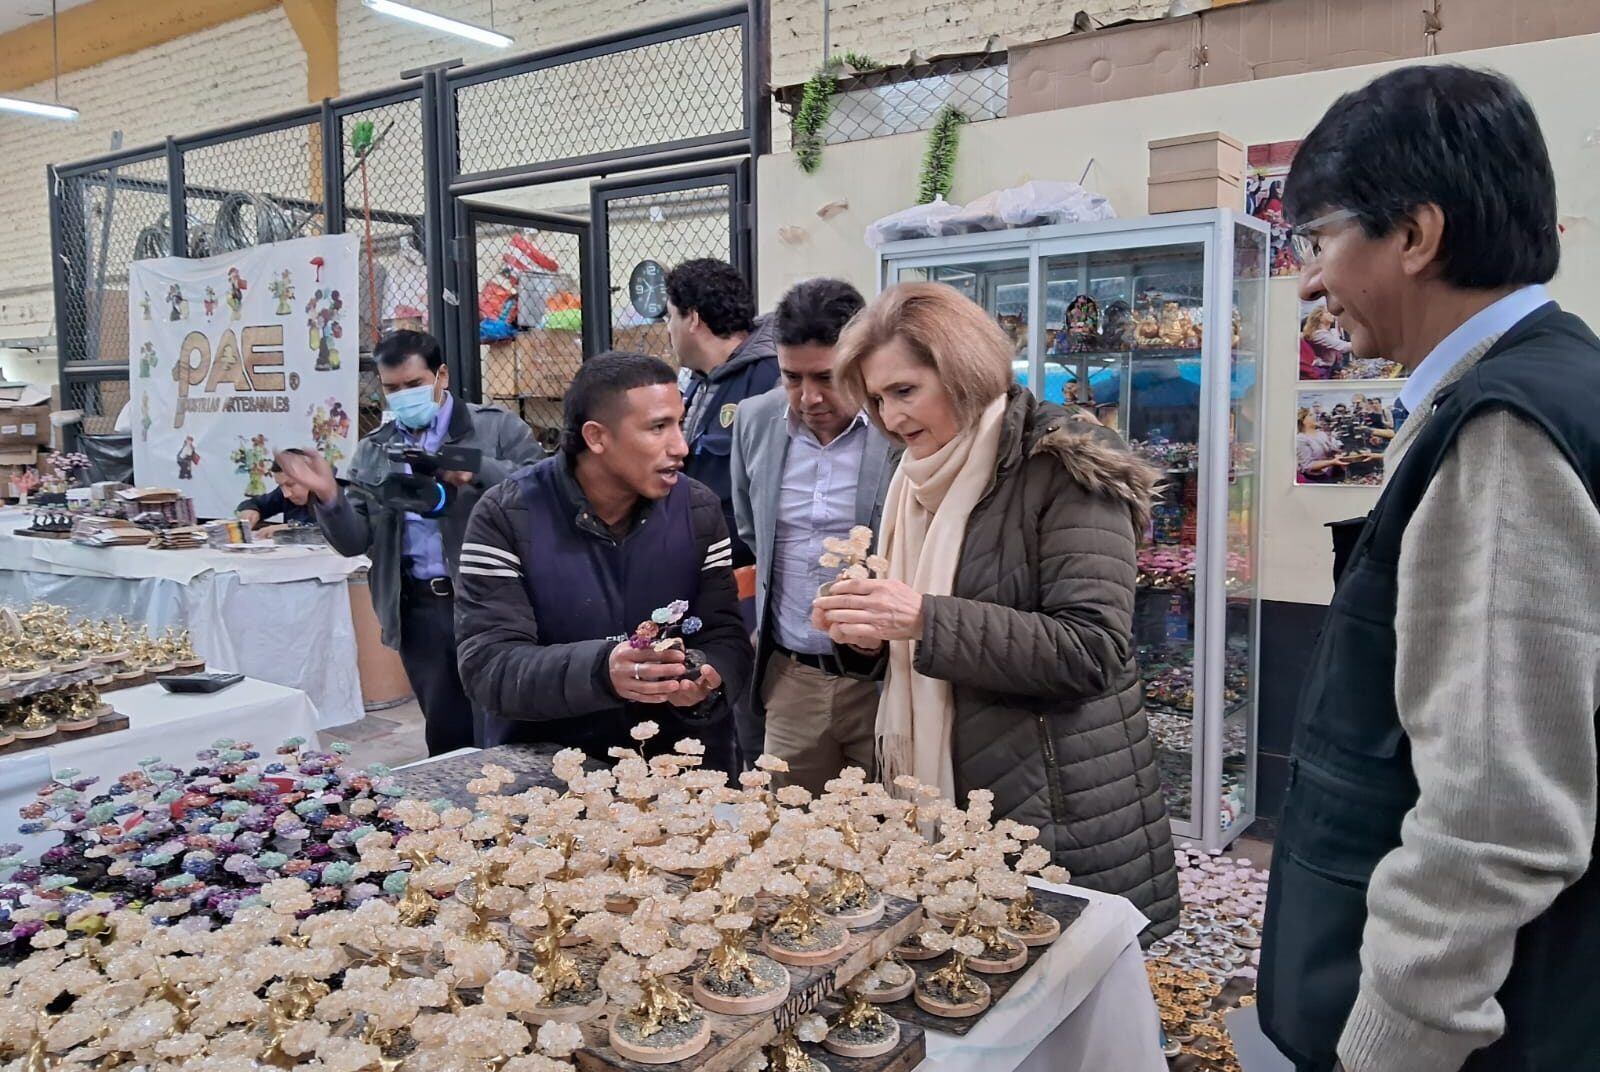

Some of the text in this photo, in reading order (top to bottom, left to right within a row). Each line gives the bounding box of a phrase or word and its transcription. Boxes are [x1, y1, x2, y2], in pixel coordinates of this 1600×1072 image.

[635, 285, 643, 294] 9
[649, 303, 656, 312] 6
[222, 396, 290, 413] ARTESANALES
